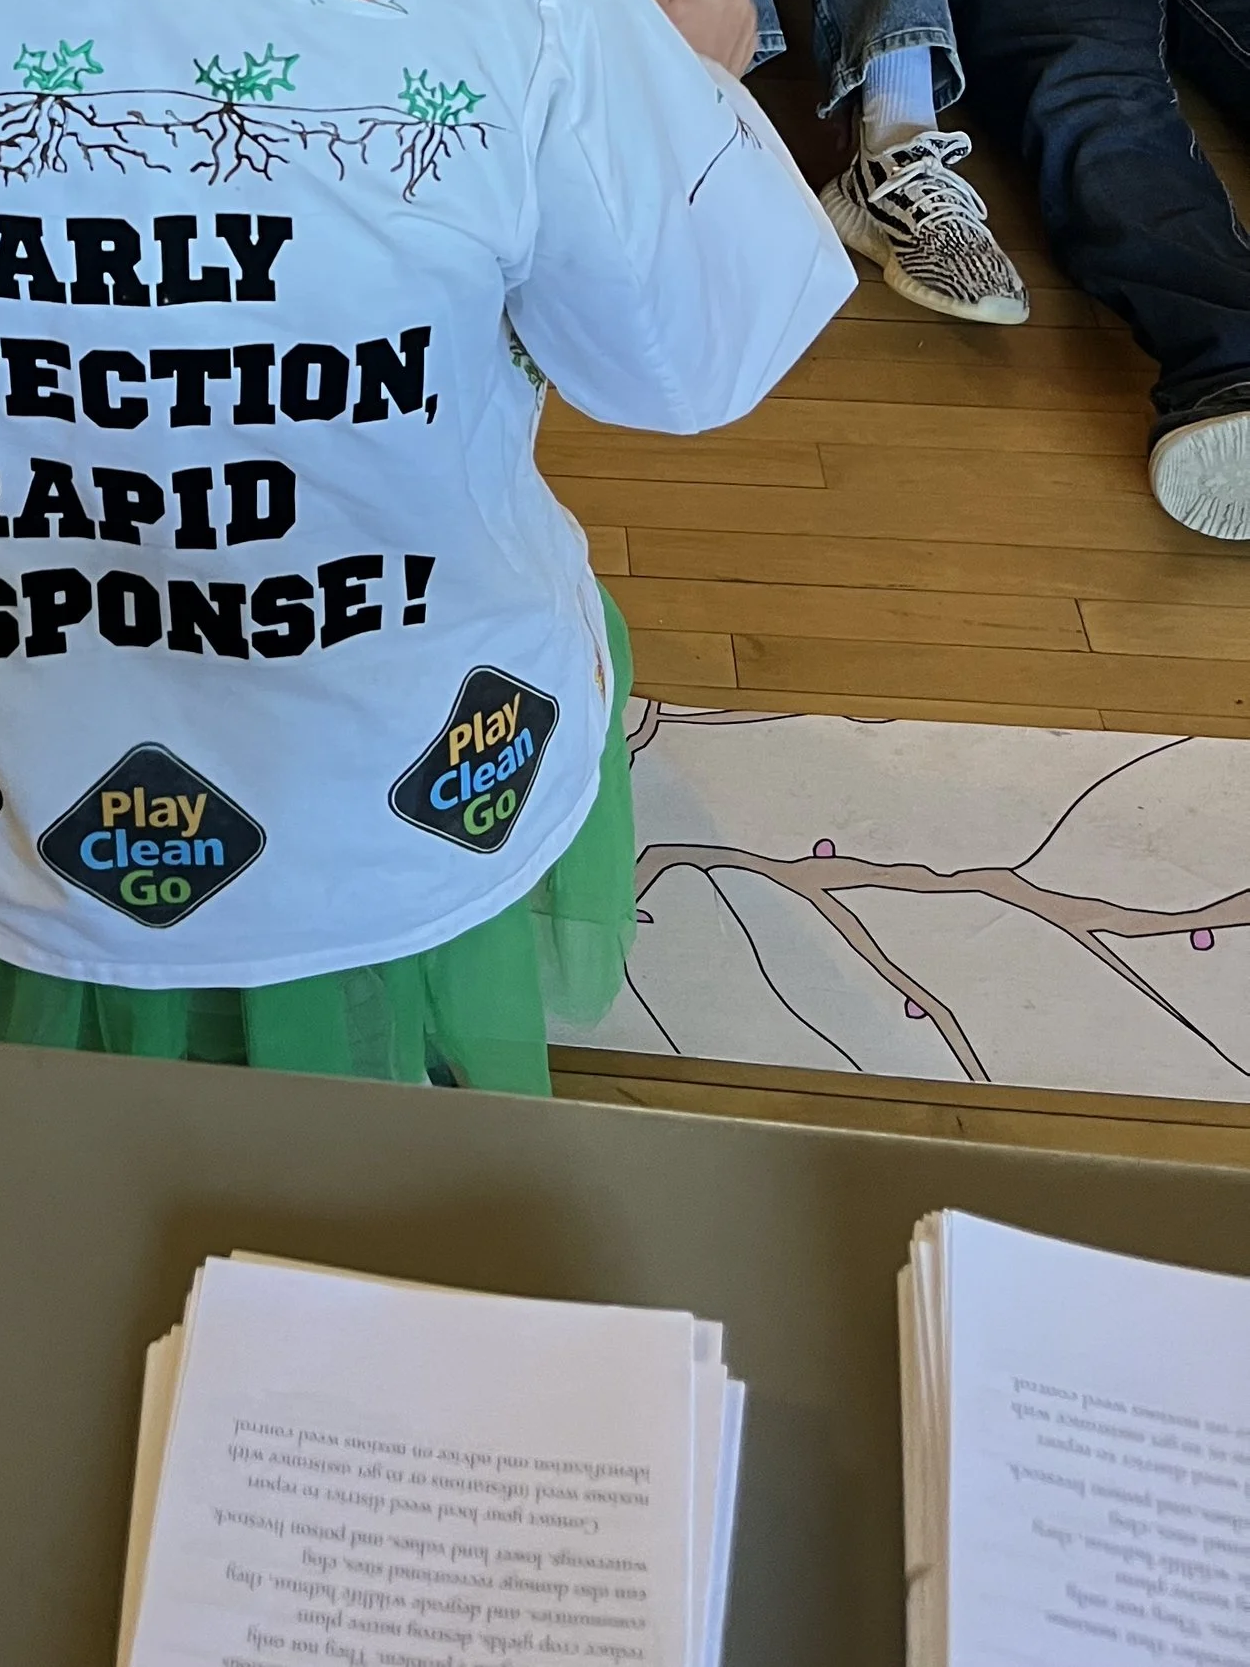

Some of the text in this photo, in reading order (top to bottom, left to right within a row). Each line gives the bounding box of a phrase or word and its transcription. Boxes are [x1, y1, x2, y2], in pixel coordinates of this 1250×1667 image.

[449, 692, 521, 767] Play
[429, 727, 535, 811] Clean
[101, 786, 208, 838] Play
[463, 788, 517, 836] Go
[79, 828, 225, 870] Clean
[119, 869, 192, 906] Go
[228, 1443, 264, 1462] with
[298, 1430, 339, 1448] weed
